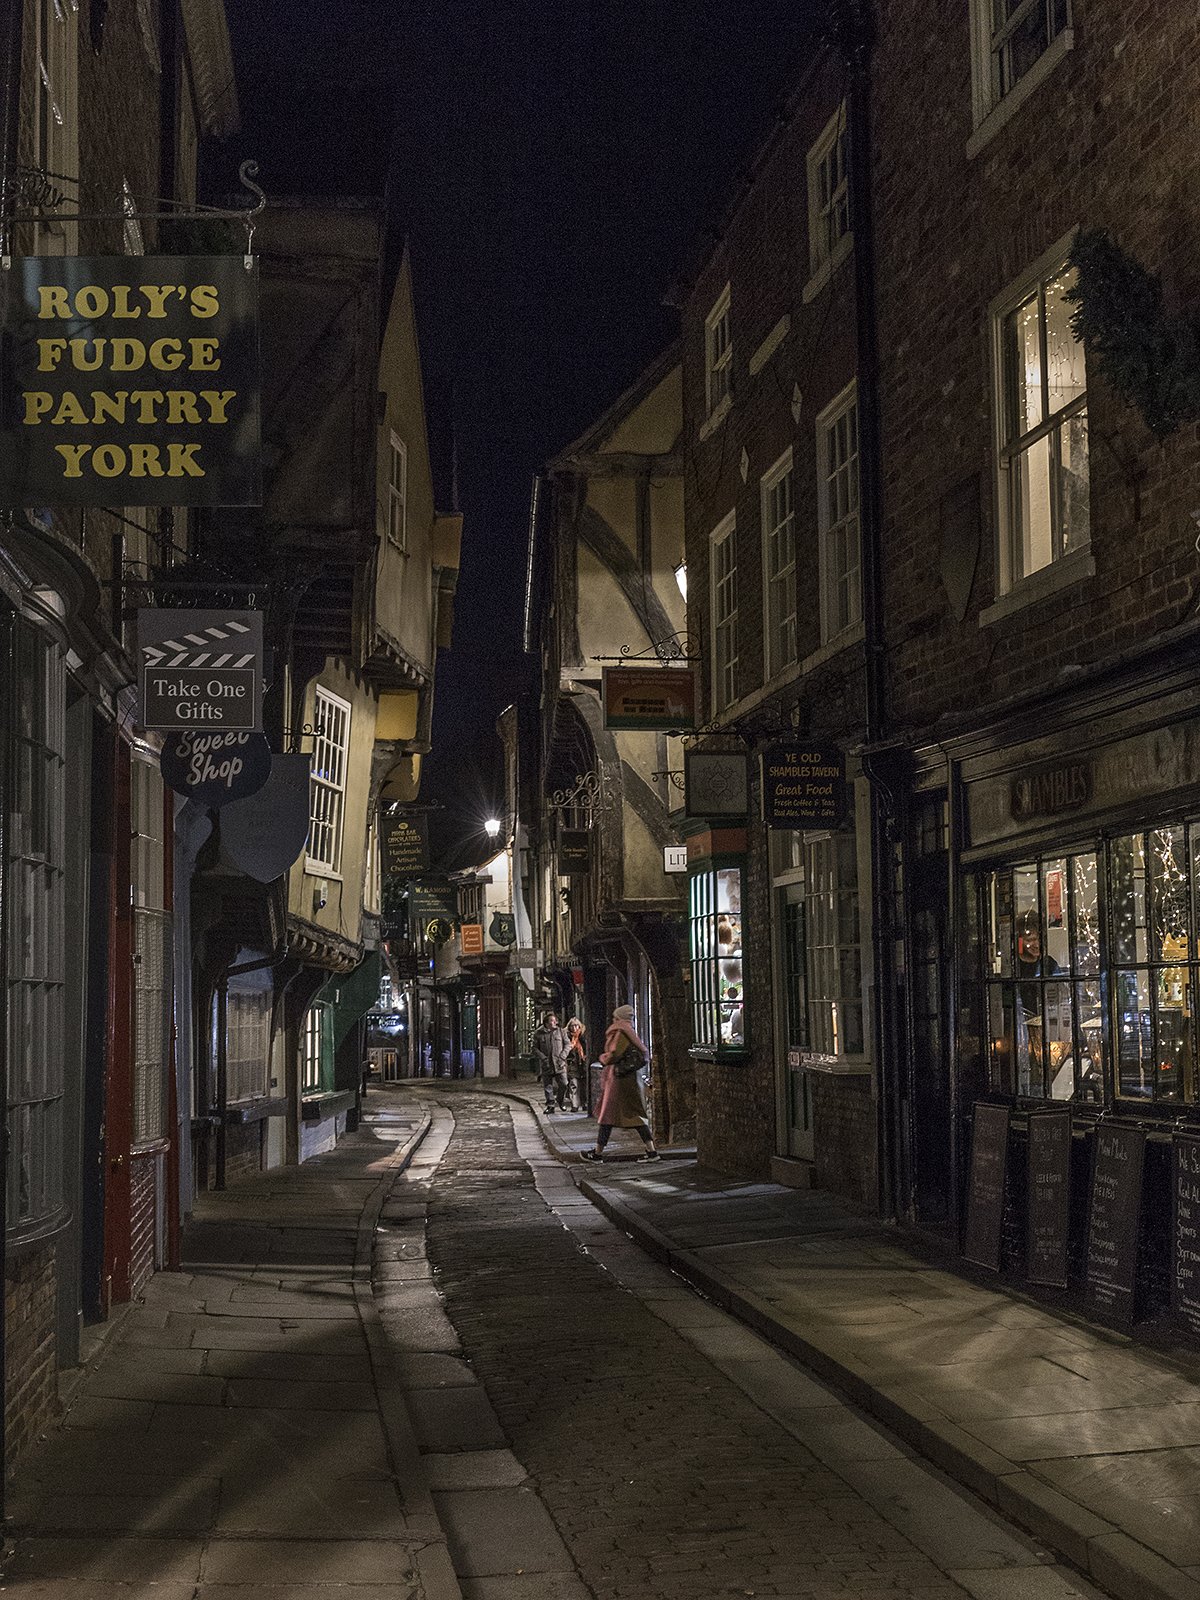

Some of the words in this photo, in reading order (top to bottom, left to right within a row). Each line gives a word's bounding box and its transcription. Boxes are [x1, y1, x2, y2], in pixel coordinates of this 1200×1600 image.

[38, 285, 220, 319] ROLY'S
[37, 337, 222, 372] FUDGE
[22, 390, 237, 425] PANTRY
[55, 443, 206, 478] YORK
[154, 678, 201, 697] Take
[206, 679, 246, 698] One
[175, 700, 224, 720] Gifts
[185, 749, 243, 787] Shop
[785, 753, 797, 763] YE
[800, 753, 821, 763] OLD
[769, 766, 810, 777] SHAMBLES
[811, 766, 840, 777] TAVERN
[775, 783, 802, 796] Great
[806, 783, 833, 795] Food
[1016, 763, 1087, 816] SHAMBLES
[389, 848, 422, 856] Handmade
[390, 864, 423, 873] Chocolates
